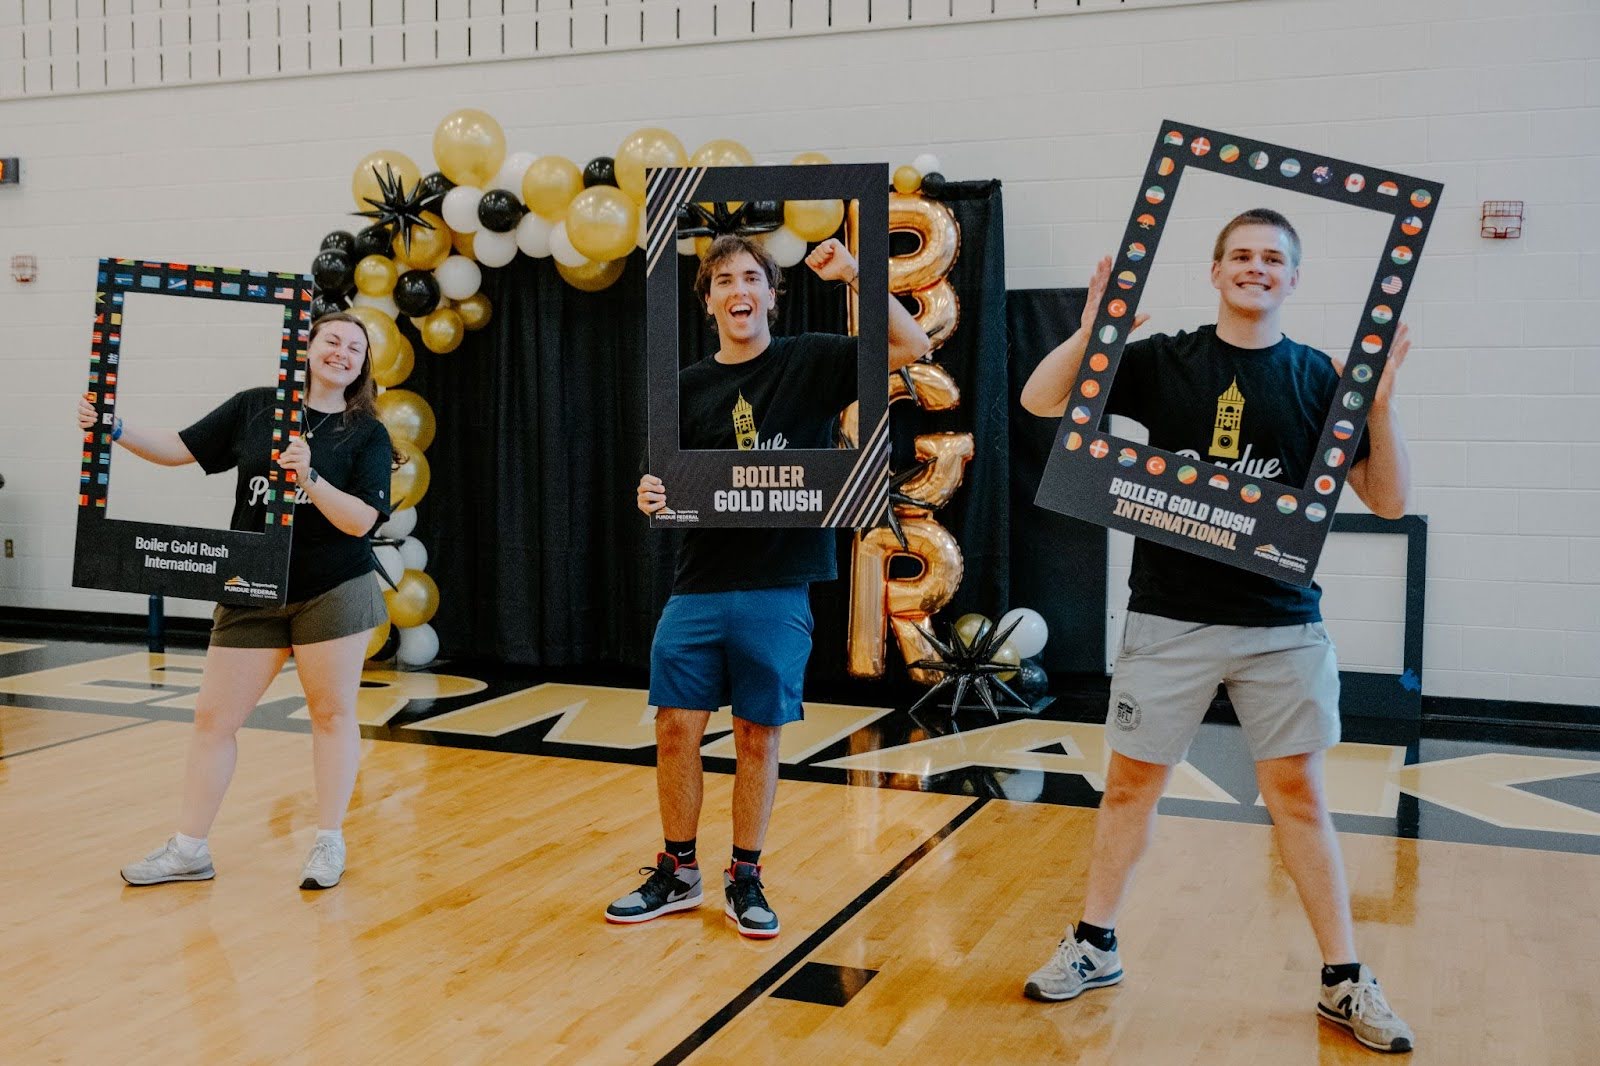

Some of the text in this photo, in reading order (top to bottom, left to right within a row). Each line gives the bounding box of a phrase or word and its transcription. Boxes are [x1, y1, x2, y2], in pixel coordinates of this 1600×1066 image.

[732, 465, 805, 488] BOILER
[713, 489, 823, 512] GOLD RUSH
[1109, 477, 1257, 536] BOILER GOLD RUSH
[1112, 498, 1237, 551] INTERNATIONAL
[135, 536, 229, 559] Boiler Gold Rush
[144, 554, 217, 574] International
[224, 585, 250, 594] PURDUE
[250, 587, 278, 597] FEDERAL
